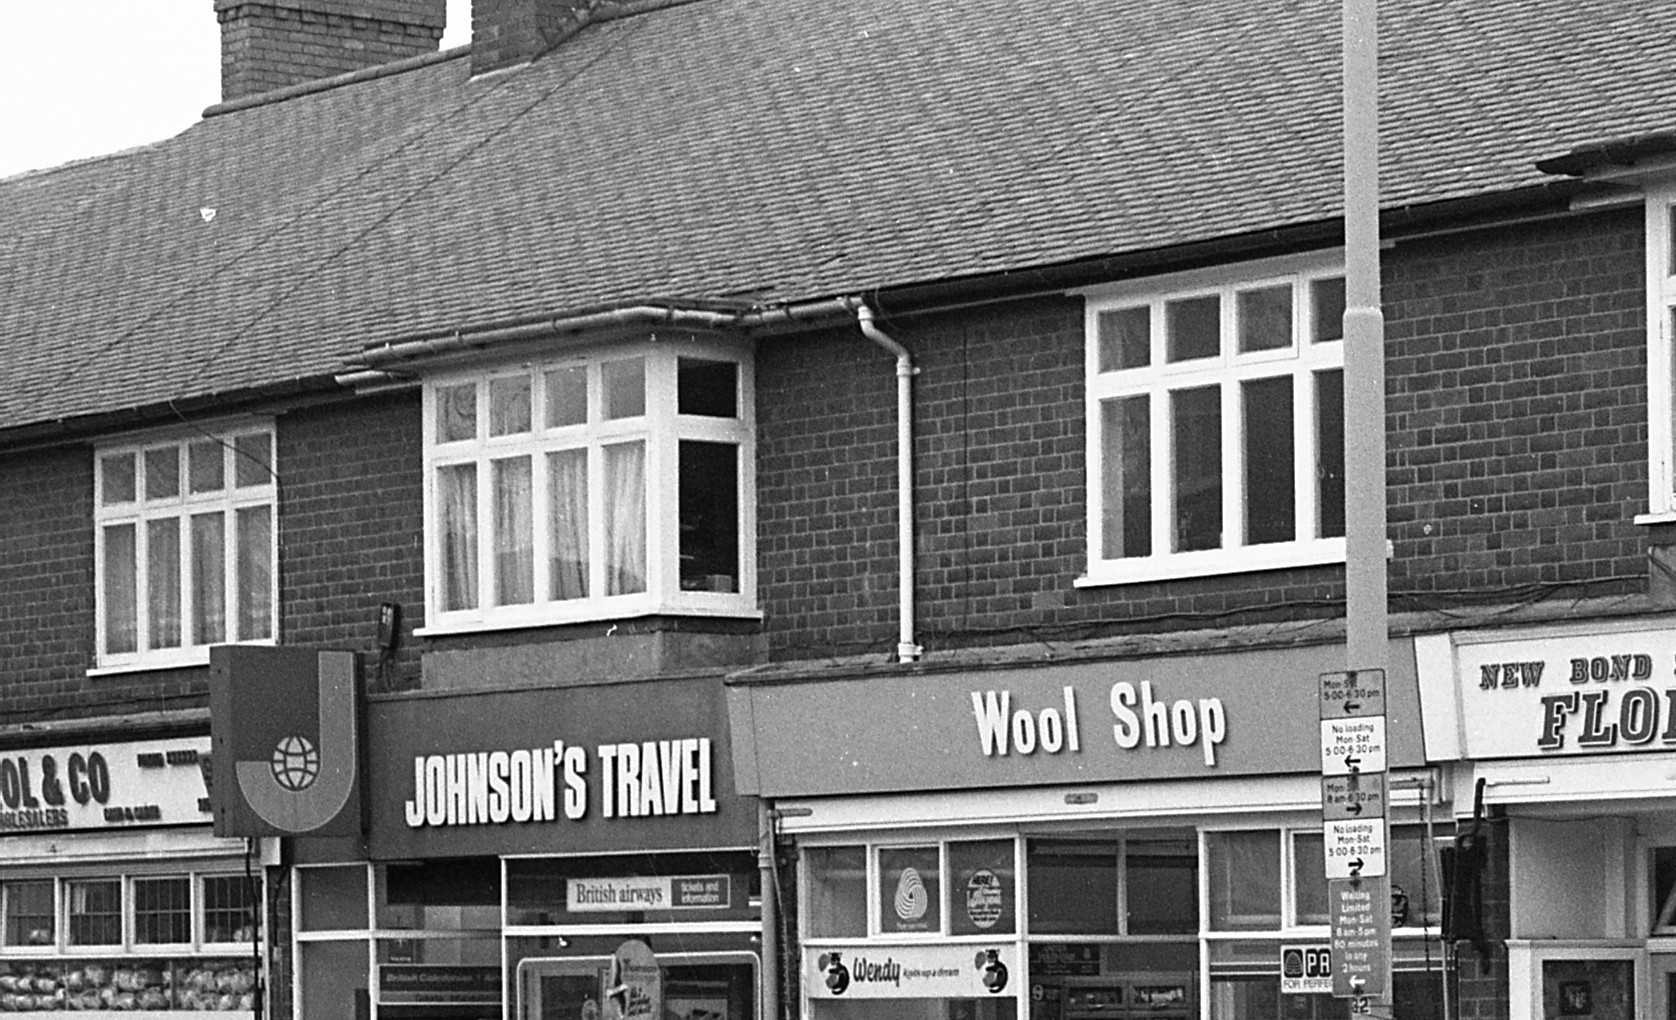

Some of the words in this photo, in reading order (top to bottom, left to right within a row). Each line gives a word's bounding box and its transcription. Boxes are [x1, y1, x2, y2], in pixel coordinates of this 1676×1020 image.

[1479, 661, 1545, 689] NEW
[1569, 653, 1651, 683] BOND
[971, 686, 1079, 756] Wool
[1110, 680, 1226, 766] Shop
[1332, 725, 1344, 733] No
[1345, 723, 1374, 733] loading
[42, 755, 65, 806] &
[68, 751, 110, 805] CO
[405, 740, 587, 827] JOHNSON'S
[599, 738, 716, 818] TRAVEL
[1333, 825, 1344, 834] No
[1345, 824, 1373, 834] loading
[576, 881, 616, 905] British
[618, 884, 663, 906] airways
[1341, 903, 1371, 913] Limited
[1347, 940, 1379, 948] minutes
[1354, 952, 1368, 962] any
[853, 956, 901, 988] Wendy
[1343, 964, 1349, 974] 2
[1283, 980, 1300, 989] FOR
